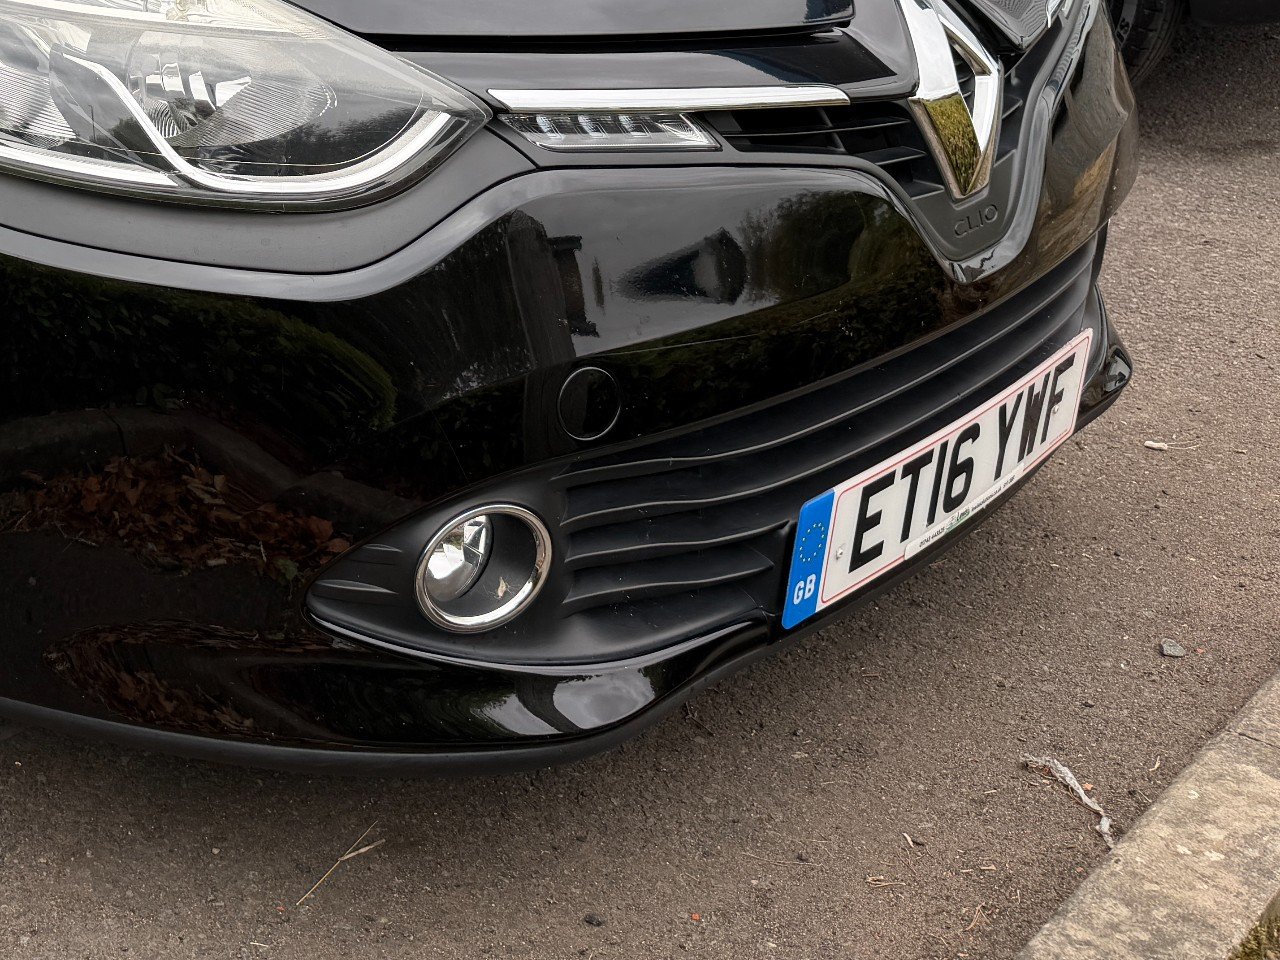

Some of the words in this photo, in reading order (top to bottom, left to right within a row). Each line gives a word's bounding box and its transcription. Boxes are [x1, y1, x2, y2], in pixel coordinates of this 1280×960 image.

[954, 204, 999, 239] CLIO
[849, 423, 980, 574] ET16
[994, 352, 1076, 482] YWF
[793, 573, 817, 605] GB
